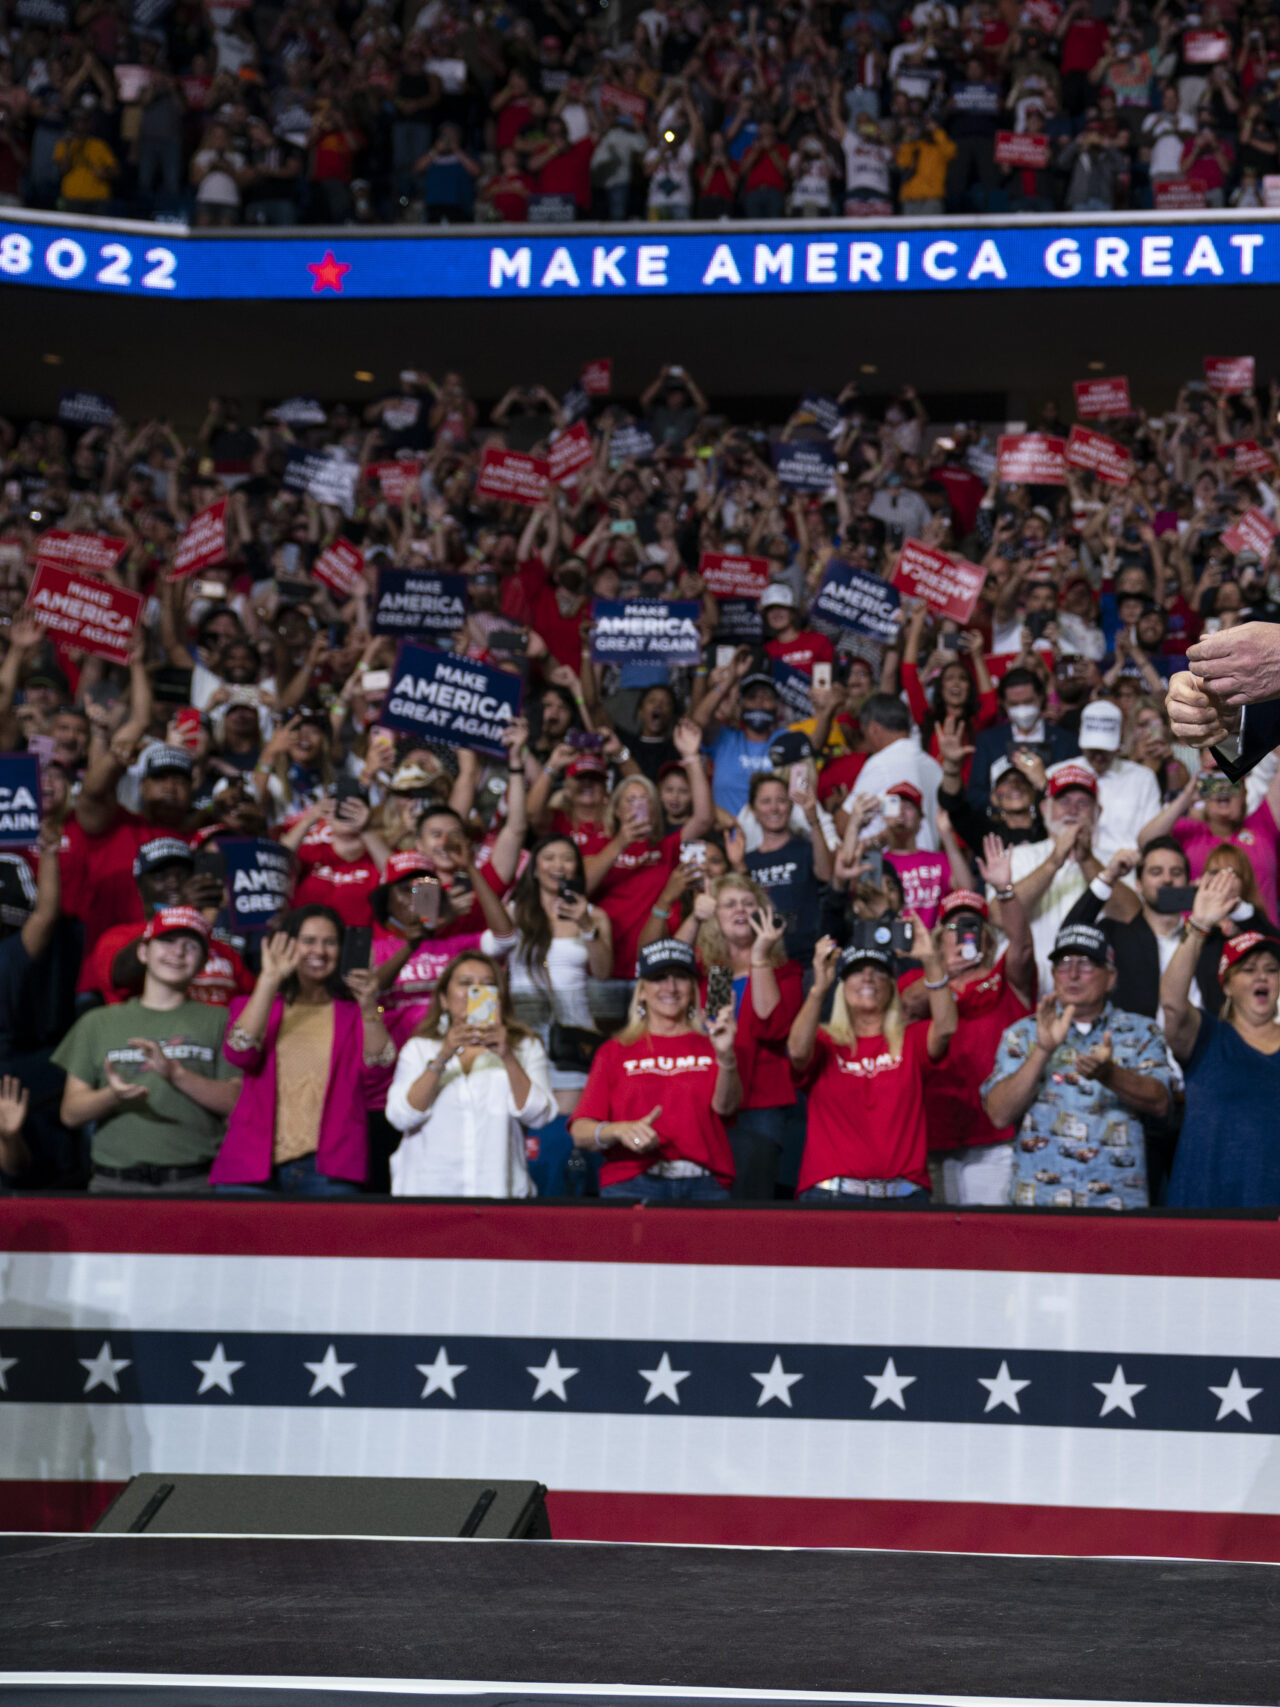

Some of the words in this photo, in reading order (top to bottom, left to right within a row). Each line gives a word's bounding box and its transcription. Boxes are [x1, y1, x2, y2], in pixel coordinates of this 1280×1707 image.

[0, 233, 176, 289] 8022
[489, 246, 669, 289] MAKE
[702, 240, 1007, 285] AMERICA
[1044, 234, 1264, 279] GREAT
[33, 587, 134, 633] AMERICA
[378, 591, 466, 615] AMERICA
[623, 604, 670, 617] MAKE
[595, 617, 698, 638] AMERICA
[594, 636, 648, 652] GREAT
[647, 636, 698, 652] AGAIN
[434, 662, 489, 693] MAKE
[388, 697, 453, 728] GREAT
[393, 673, 514, 722] AMERICA
